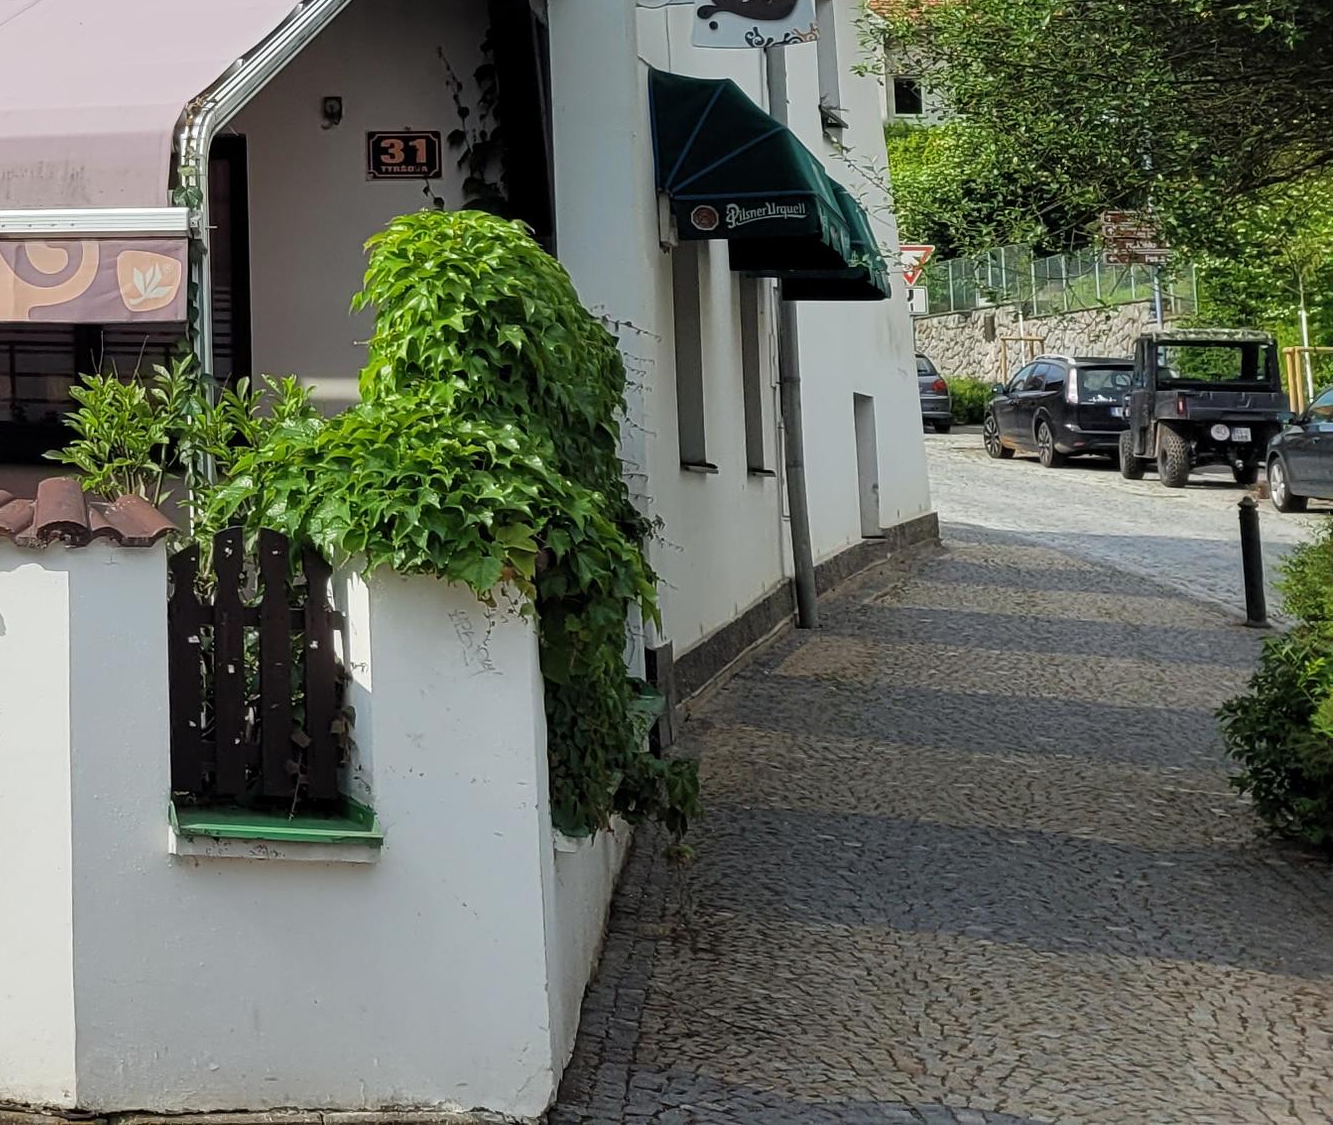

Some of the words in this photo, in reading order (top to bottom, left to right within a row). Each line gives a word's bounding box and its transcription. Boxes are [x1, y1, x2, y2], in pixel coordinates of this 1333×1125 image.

[380, 138, 427, 164] 31
[725, 203, 767, 229] Pilsner
[765, 201, 806, 219] Urquell
